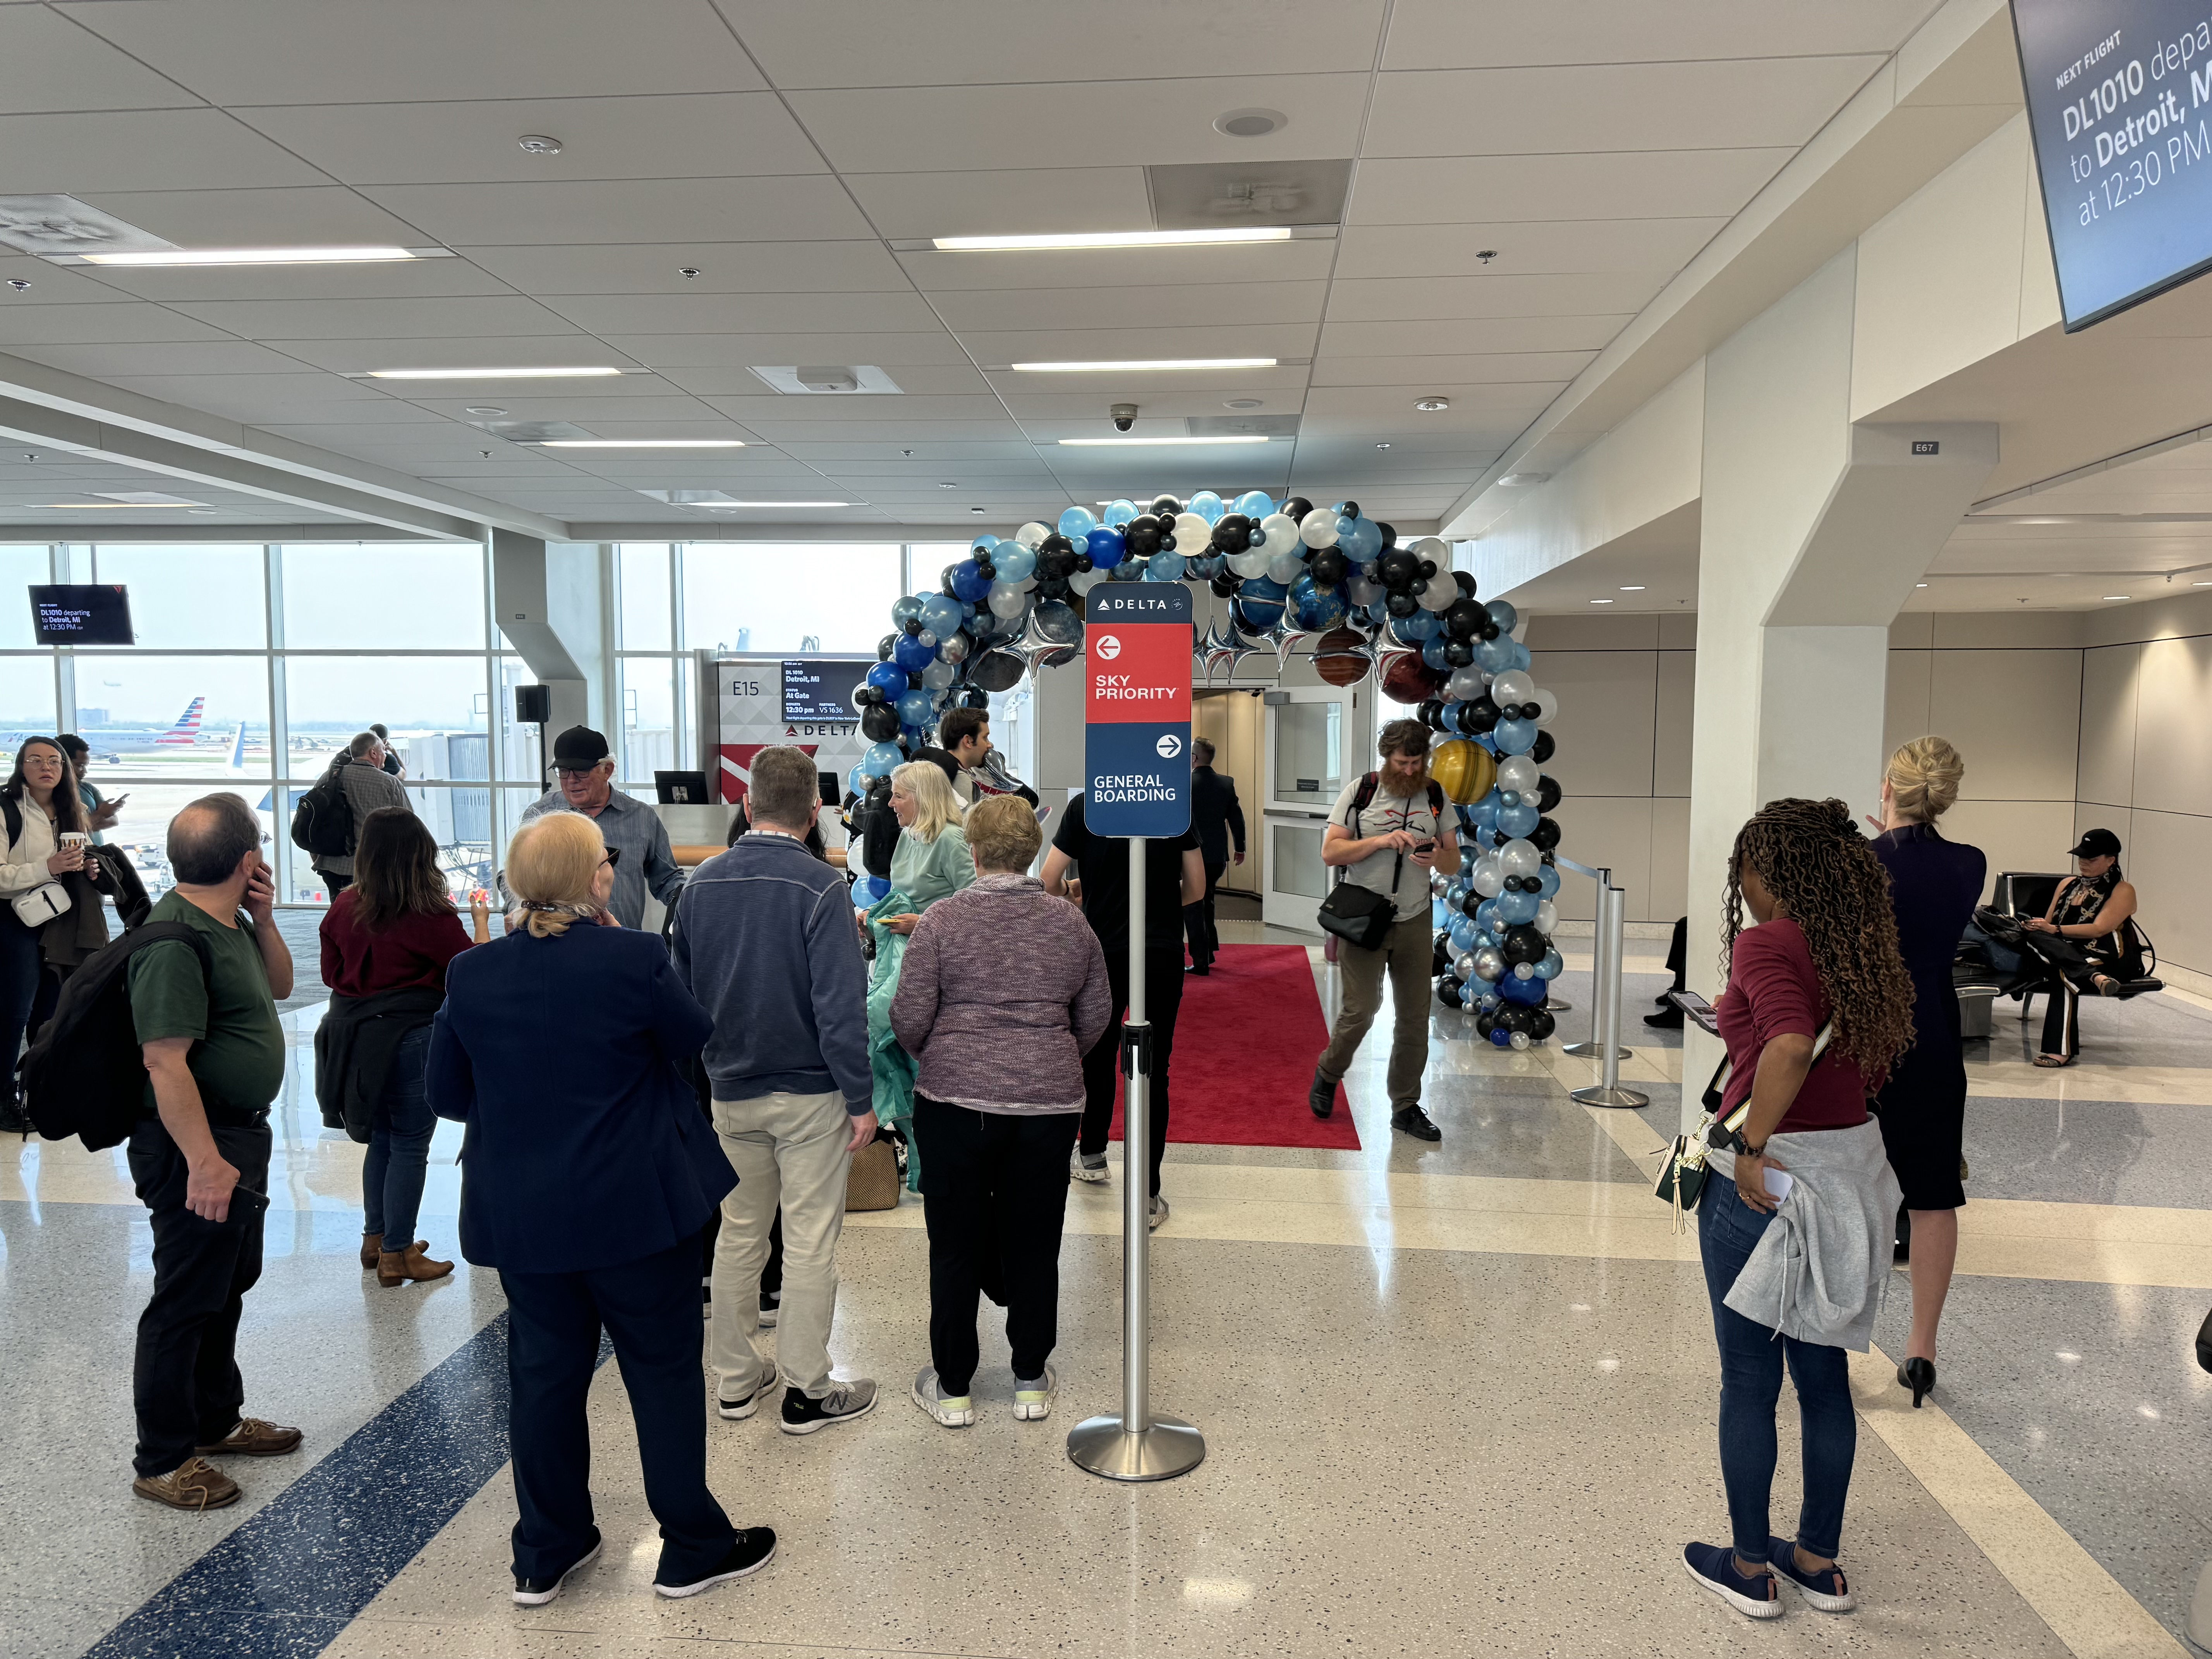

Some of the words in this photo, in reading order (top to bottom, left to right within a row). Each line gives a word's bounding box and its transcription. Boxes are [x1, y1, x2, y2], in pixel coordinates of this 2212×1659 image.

[2056, 60, 2081, 90] NEXT
[2084, 30, 2120, 69] FLIGHT
[2063, 60, 2143, 141] DL1010
[2152, 17, 2212, 80] depa
[2071, 155, 2091, 183] to
[2095, 89, 2185, 168] Detroit,
[2079, 191, 2099, 226] at
[2101, 151, 2160, 210] 12:30
[2168, 120, 2210, 174] PM
[1115, 599, 1166, 610] DELTA
[1096, 675, 1130, 687] SKY
[733, 681, 759, 696] E15
[1096, 688, 1177, 699] PRIORITY
[1094, 775, 1163, 788] GENERAL
[1095, 788, 1176, 802] BOARDING
